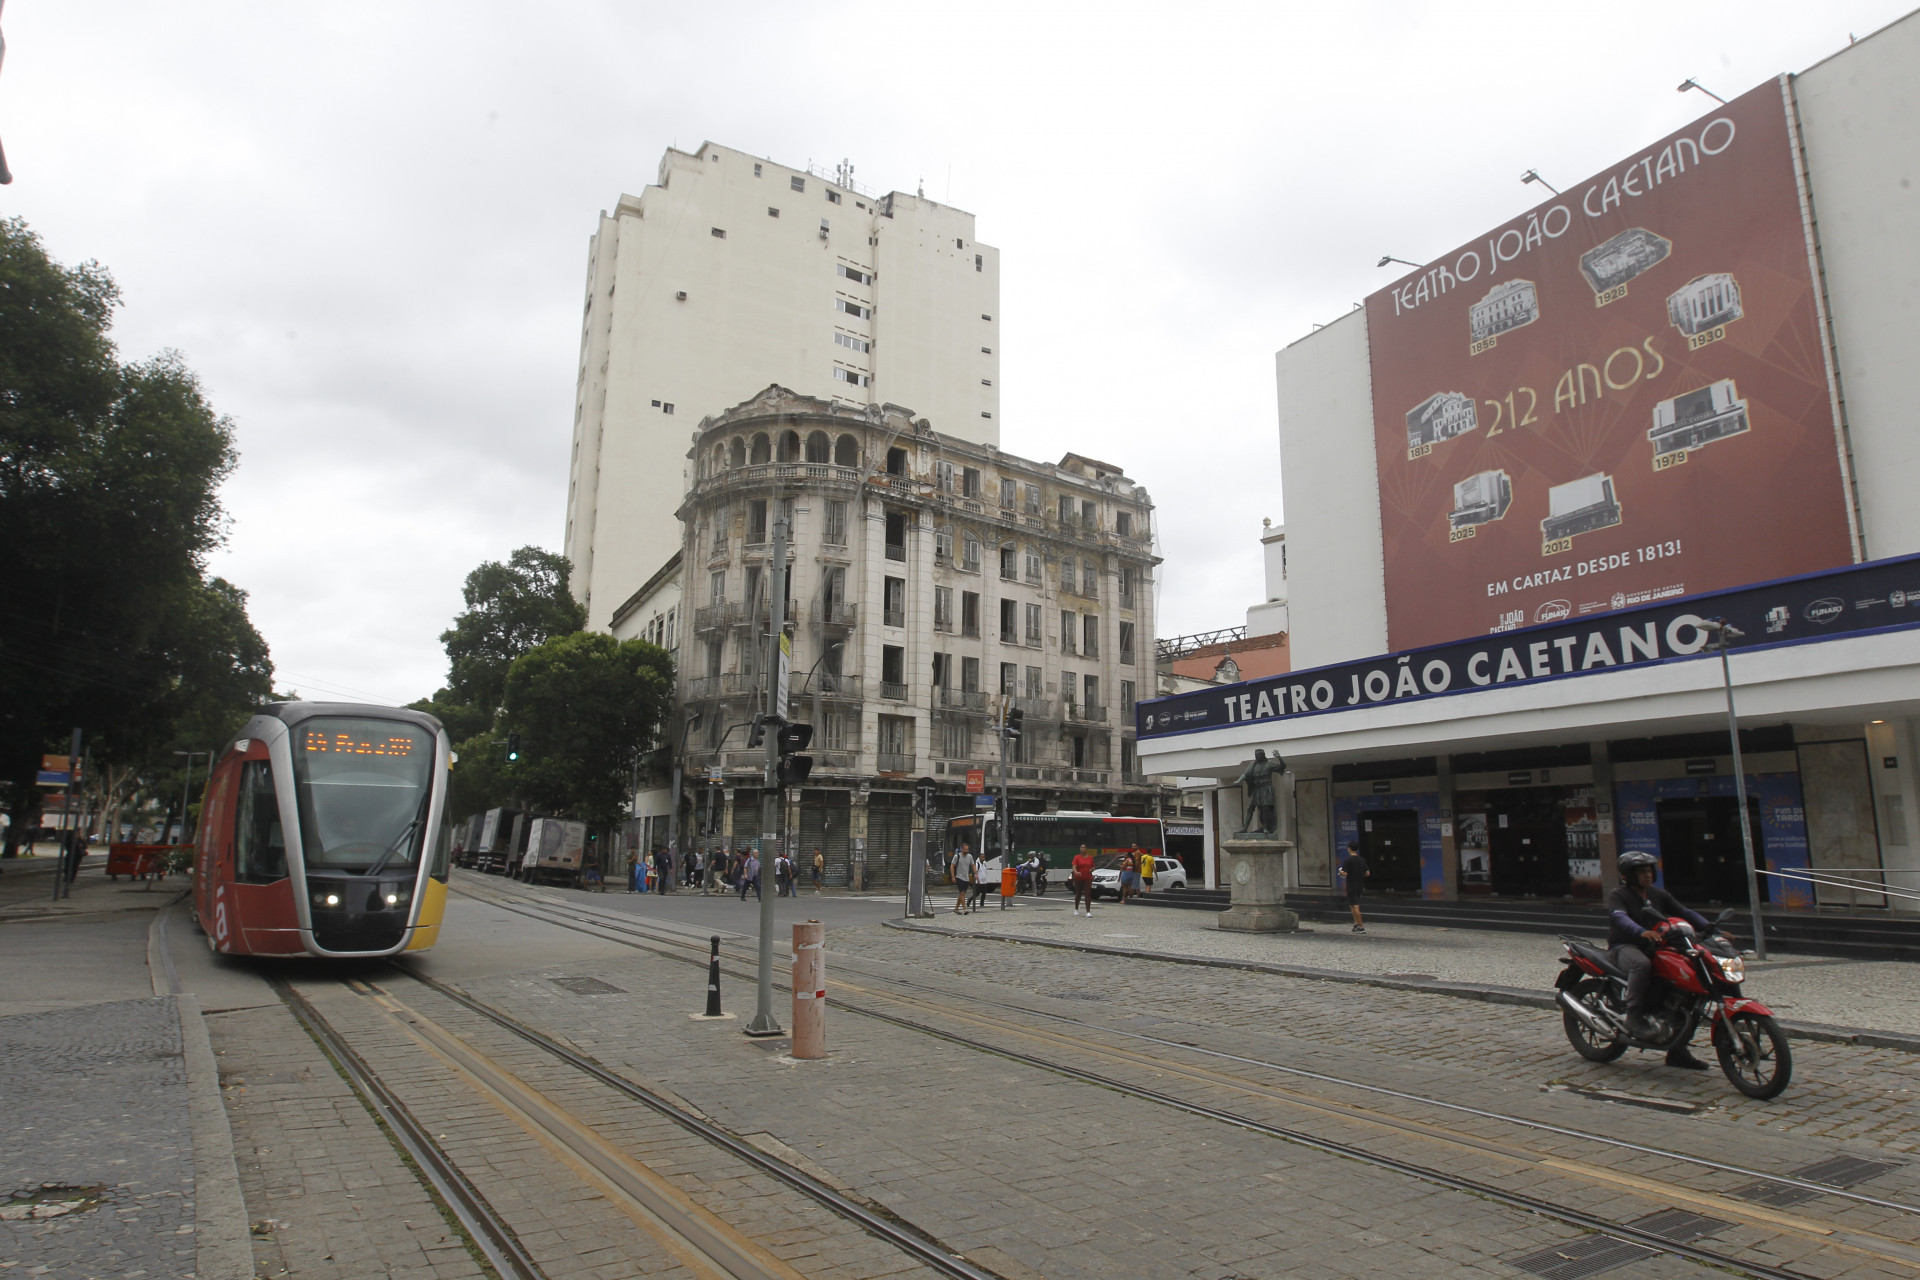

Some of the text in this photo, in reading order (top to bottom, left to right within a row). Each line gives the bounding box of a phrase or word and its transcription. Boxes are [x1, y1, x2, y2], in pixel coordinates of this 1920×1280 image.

[1391, 117, 1736, 316] TEATRO JOÃO CAETANO
[1598, 285, 1627, 305] 1928
[1470, 337, 1496, 354] 1856
[1690, 326, 1725, 348] 1930
[1483, 336, 1664, 438] 212 ANOS
[1408, 444, 1431, 459] 1813
[1654, 450, 1688, 470] 1979
[1450, 525, 1476, 542] 2025
[1544, 539, 1570, 555] 2012
[1487, 539, 1682, 597] EM CARTAZ DESDE 1813!
[1626, 587, 1685, 604] RIO DE JANEIRO
[1504, 609, 1524, 625] JOÃO
[1224, 614, 1710, 724] TEATRO JOÃO CAETANO
